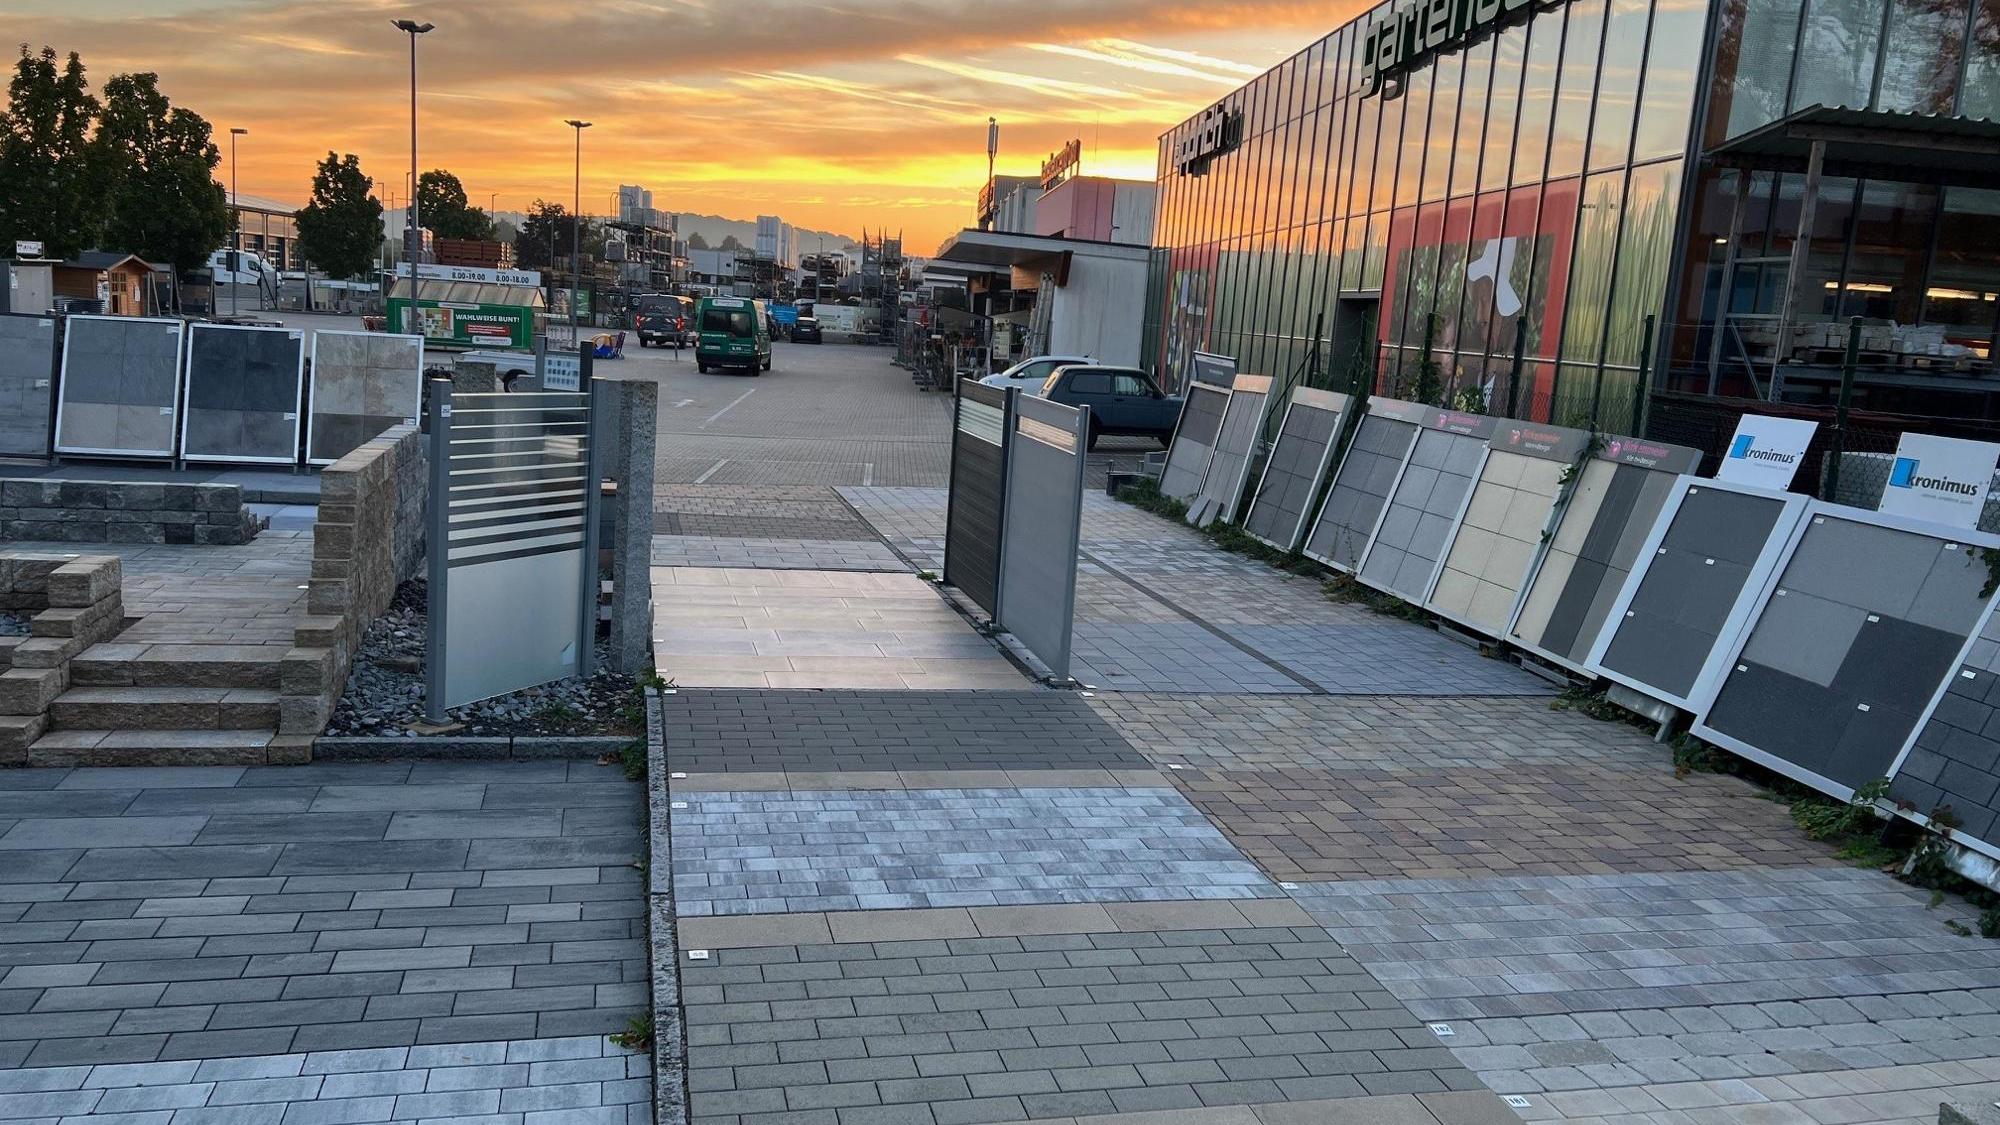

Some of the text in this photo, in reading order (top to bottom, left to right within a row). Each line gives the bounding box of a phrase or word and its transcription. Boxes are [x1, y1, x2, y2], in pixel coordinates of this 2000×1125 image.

[1358, 0, 1530, 99] garten
[455, 314, 520, 323] WAHLWEISE BUNT!
[1743, 436, 1795, 464] kronimus
[1906, 461, 1978, 496] kronimus
